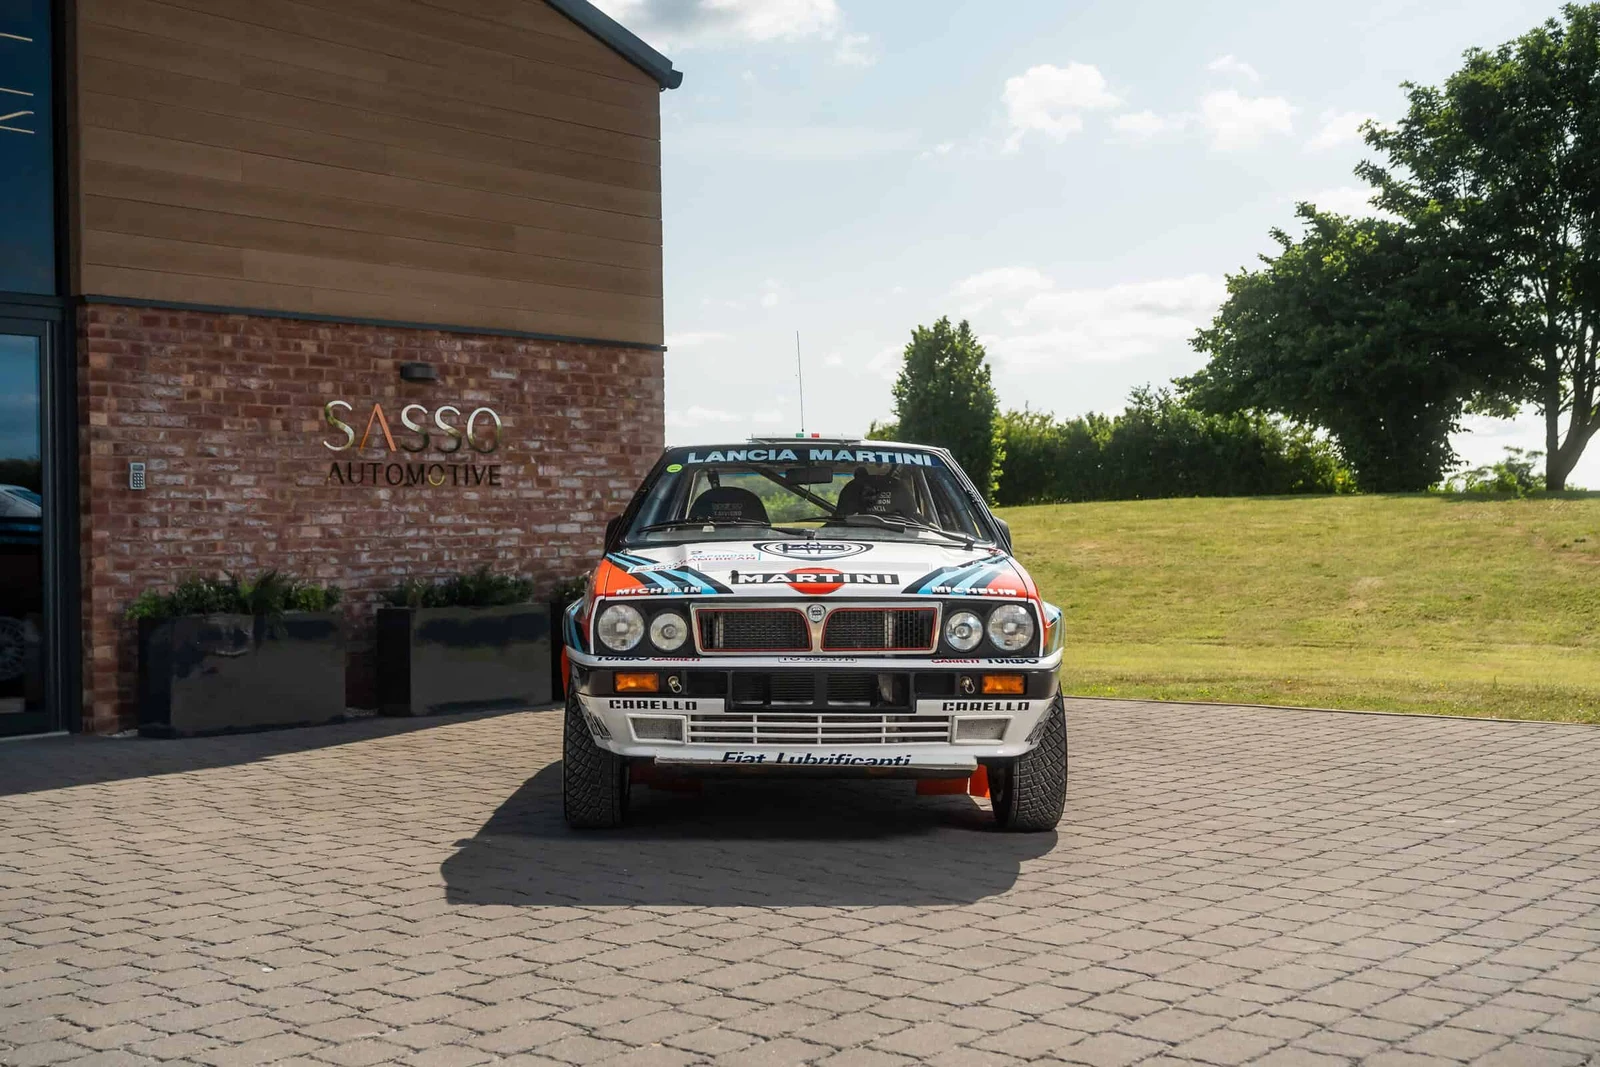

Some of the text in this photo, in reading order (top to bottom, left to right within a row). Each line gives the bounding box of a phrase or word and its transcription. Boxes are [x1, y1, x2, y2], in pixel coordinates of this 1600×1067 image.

[323, 400, 502, 453] SASSO
[687, 449, 932, 466] LANCIA MARTINI
[326, 462, 501, 486] AUTOMOTIVE
[738, 573, 894, 584] MARTINI
[615, 586, 702, 595] MICHELIN
[931, 586, 1017, 596] MICHELIN
[608, 699, 698, 711] CARELLO
[942, 701, 1030, 711] CARELLO
[721, 751, 912, 766] Fiat Lubrificanti
